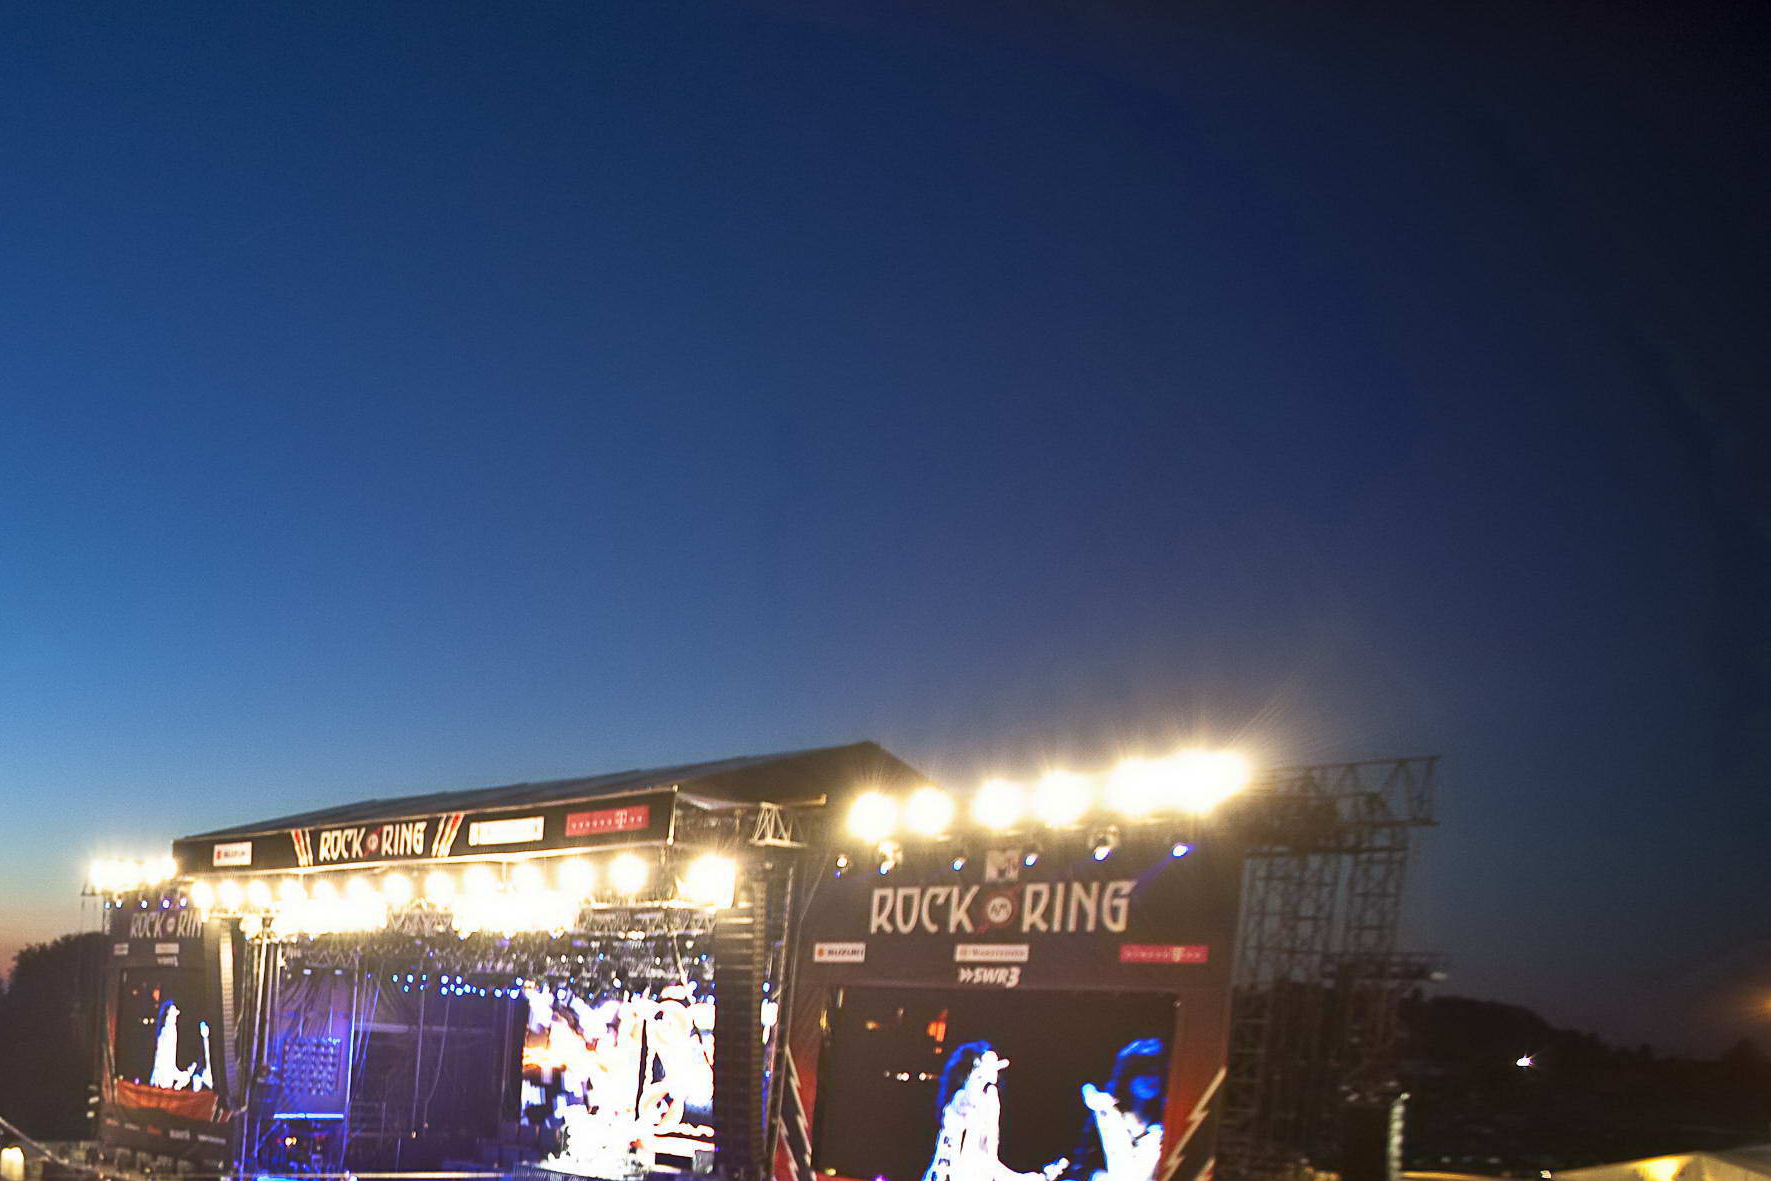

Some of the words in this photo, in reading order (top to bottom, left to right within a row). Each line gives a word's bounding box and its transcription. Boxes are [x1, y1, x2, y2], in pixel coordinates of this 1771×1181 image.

[319, 827, 366, 862] ROCK
[381, 822, 427, 856] RING
[130, 912, 166, 938] ROCK
[177, 909, 203, 938] RIN
[870, 885, 980, 934] ROCK
[1022, 880, 1137, 933] RING
[974, 966, 1021, 988] SWR3
